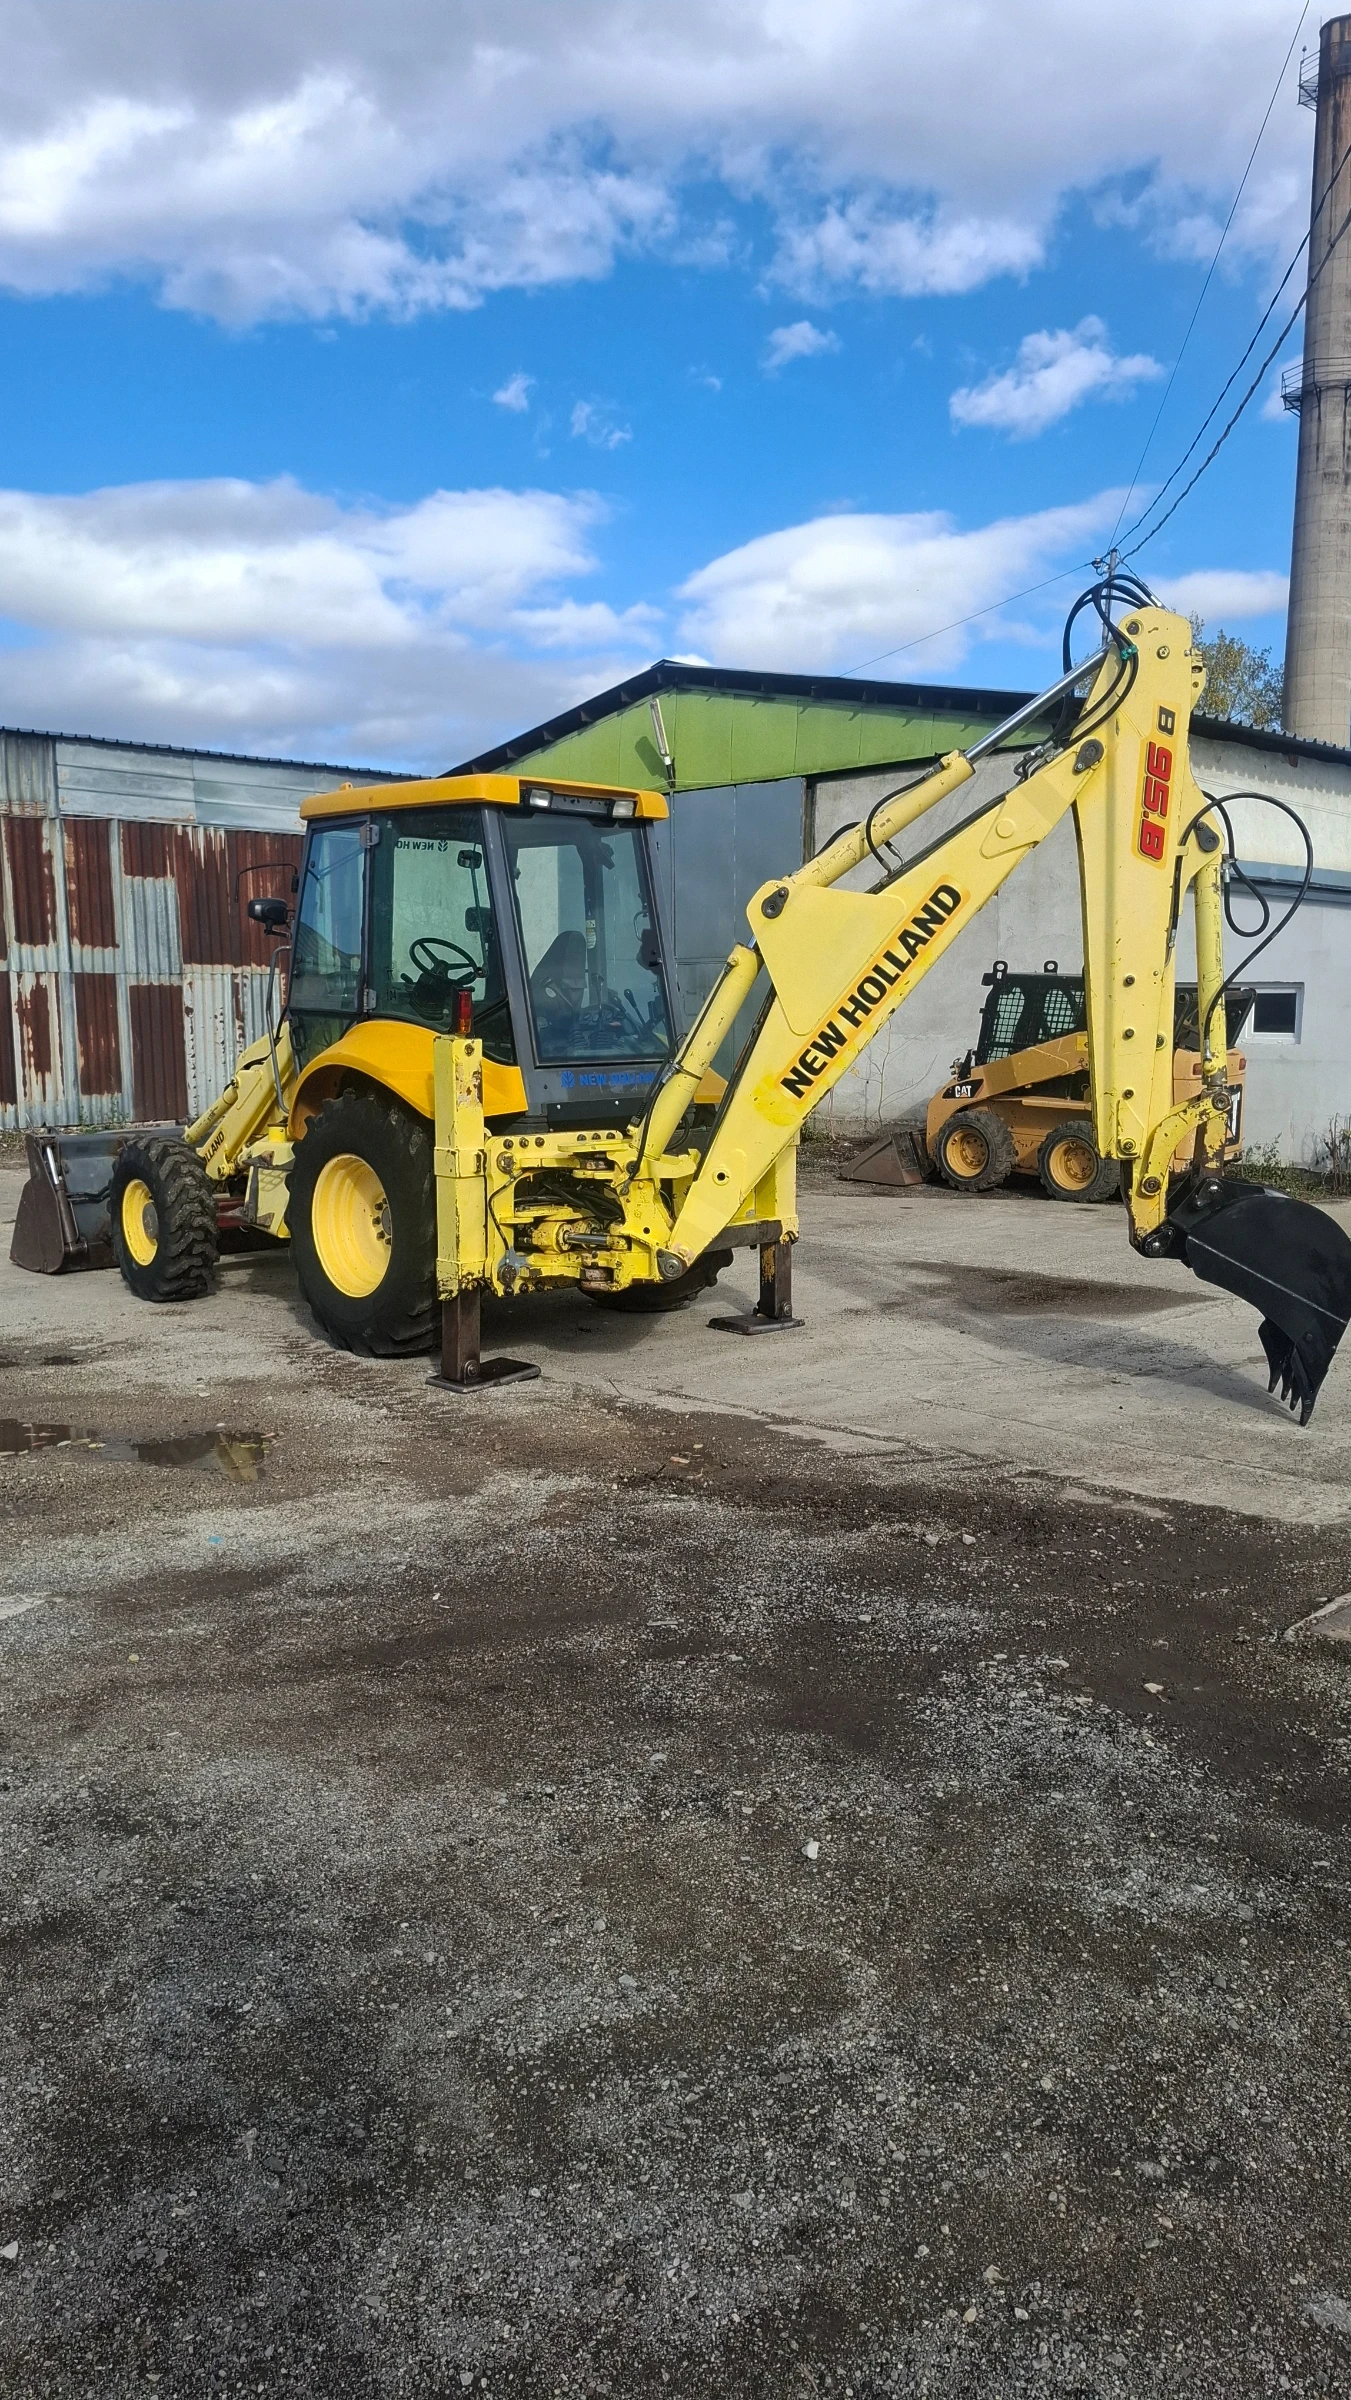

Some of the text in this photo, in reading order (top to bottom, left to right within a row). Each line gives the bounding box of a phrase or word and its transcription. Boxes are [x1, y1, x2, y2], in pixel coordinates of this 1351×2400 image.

[780, 884, 962, 1099] NEW HOLLAND
[579, 1073, 607, 1086] NEW
[955, 1085, 972, 1098] CAT
[203, 1130, 225, 1163] LLAND
